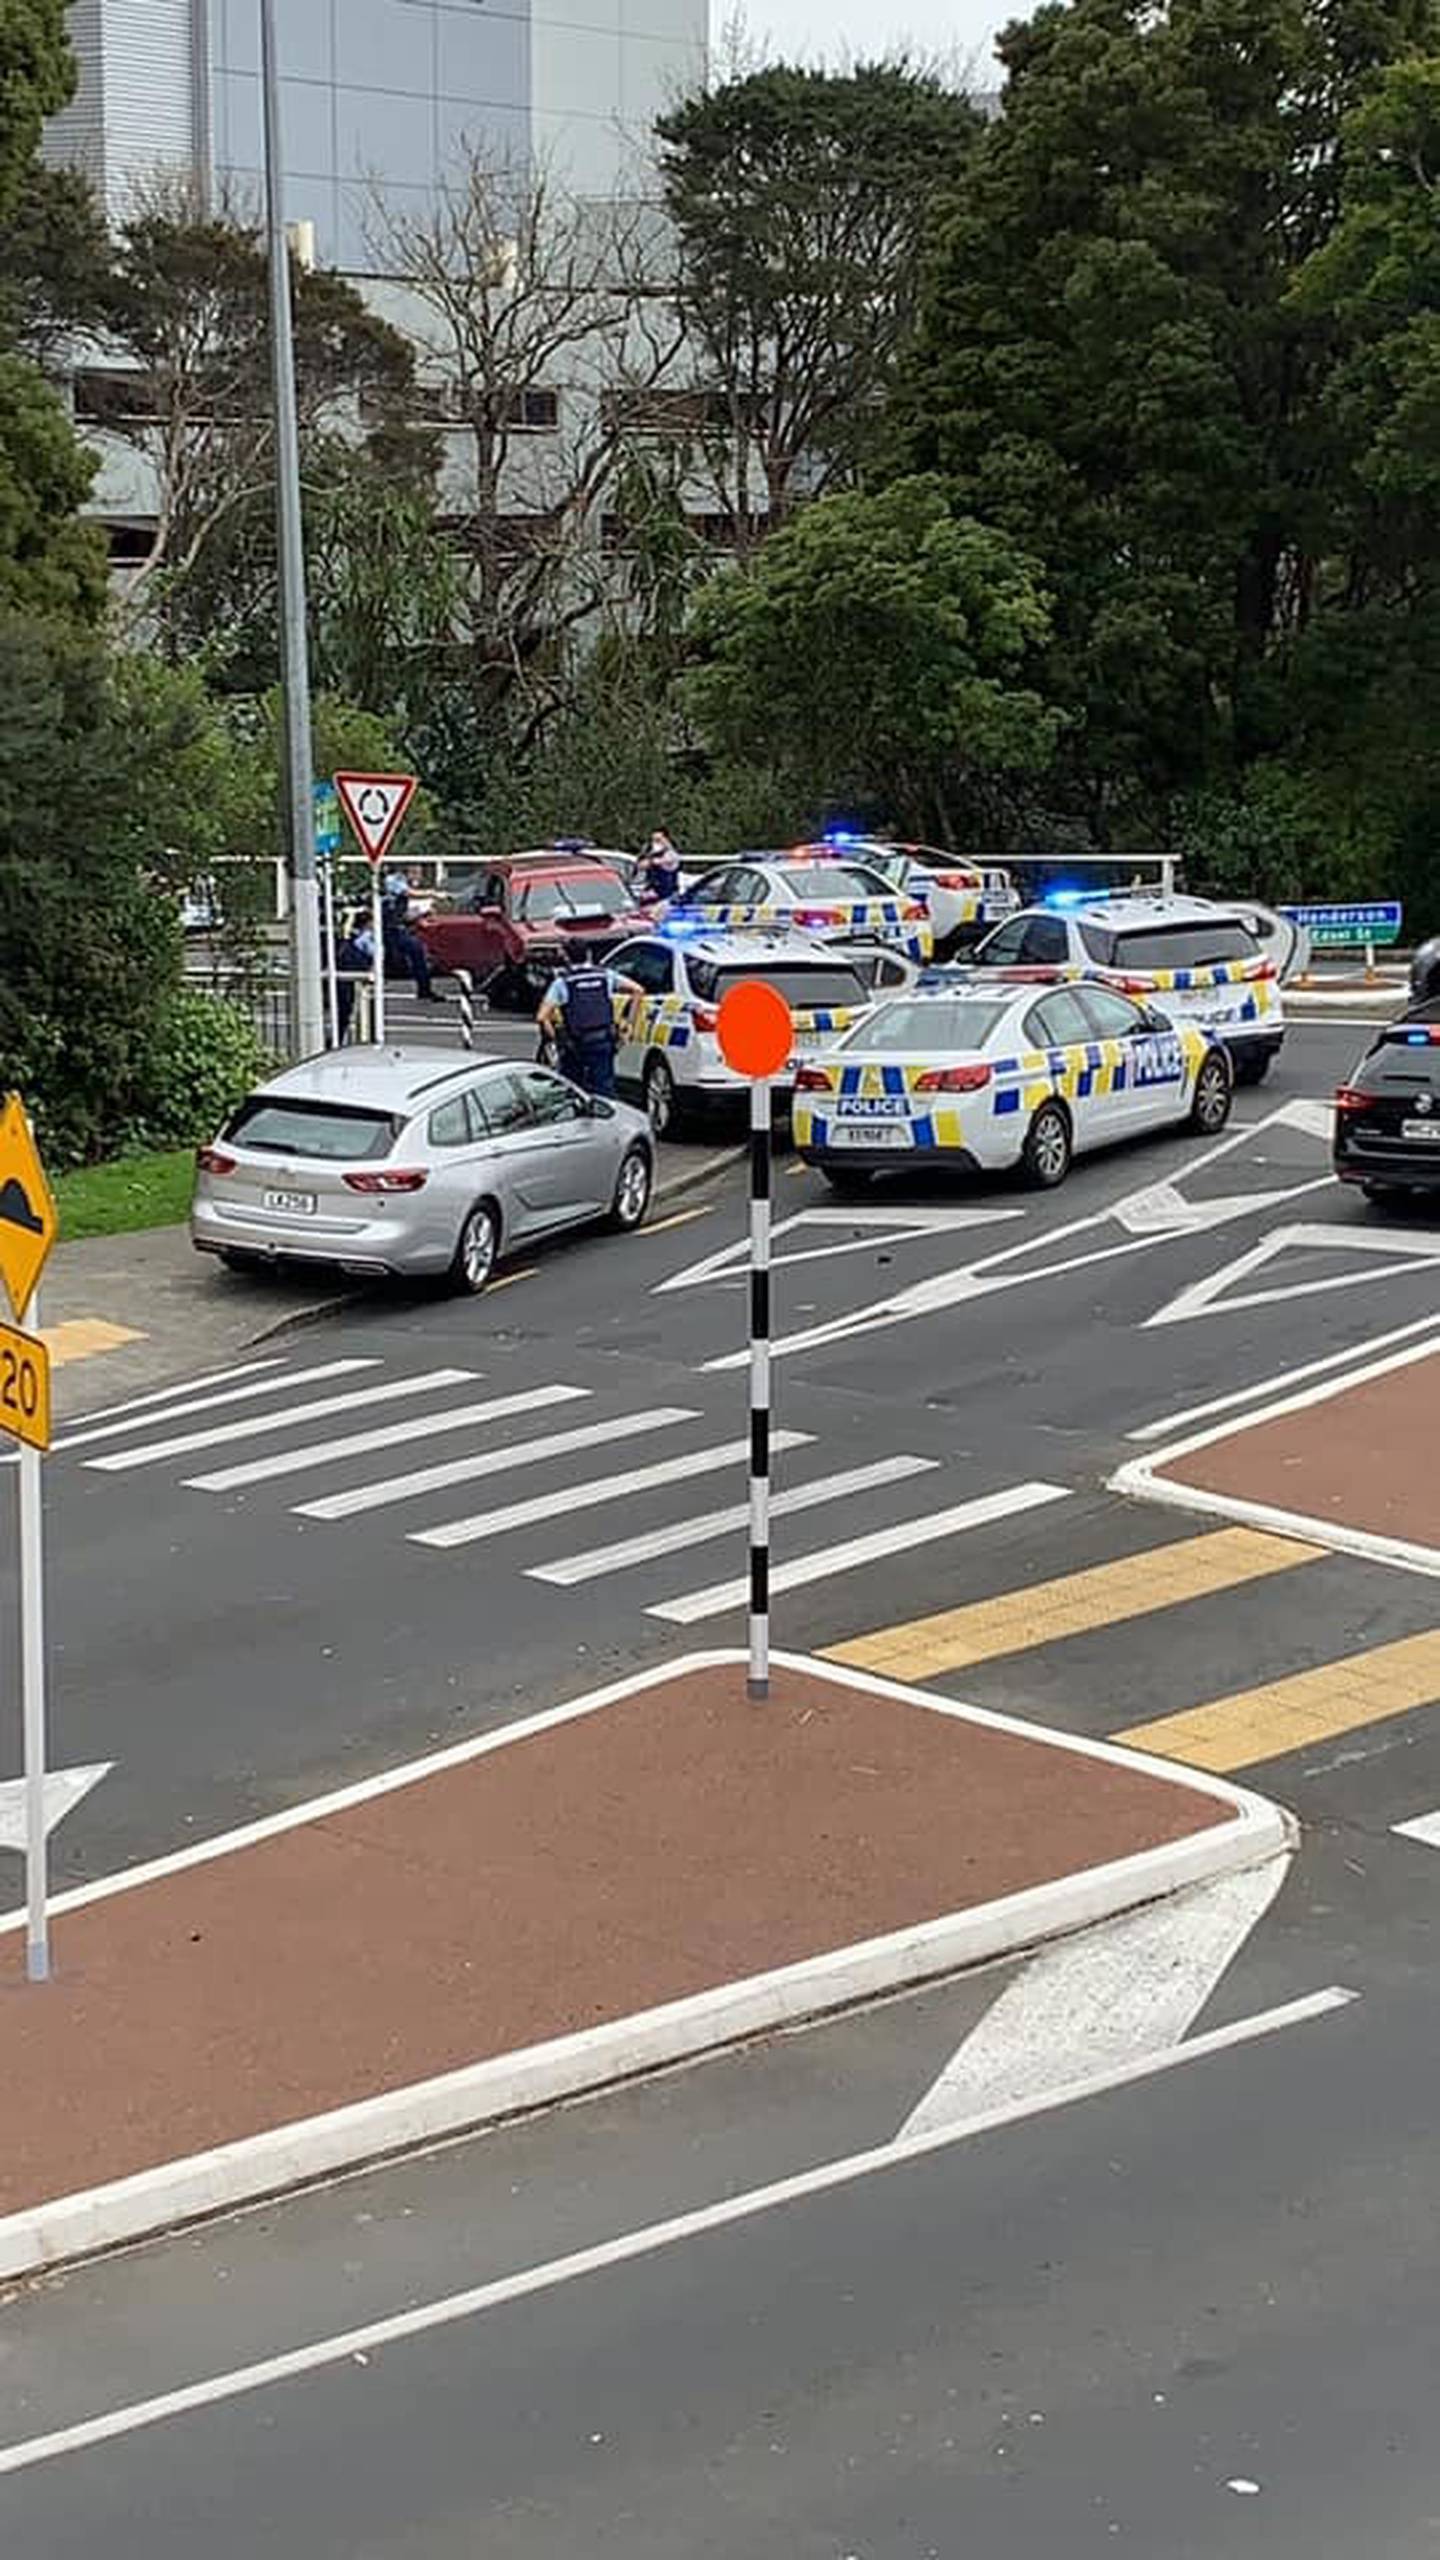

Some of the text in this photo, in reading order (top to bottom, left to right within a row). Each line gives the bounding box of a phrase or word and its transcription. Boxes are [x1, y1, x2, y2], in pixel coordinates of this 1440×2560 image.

[1298, 909, 1387, 923] Henderson
[1135, 1040, 1183, 1082] POLICE
[840, 1099, 904, 1114] POLICE
[2, 1348, 39, 1419] 20
